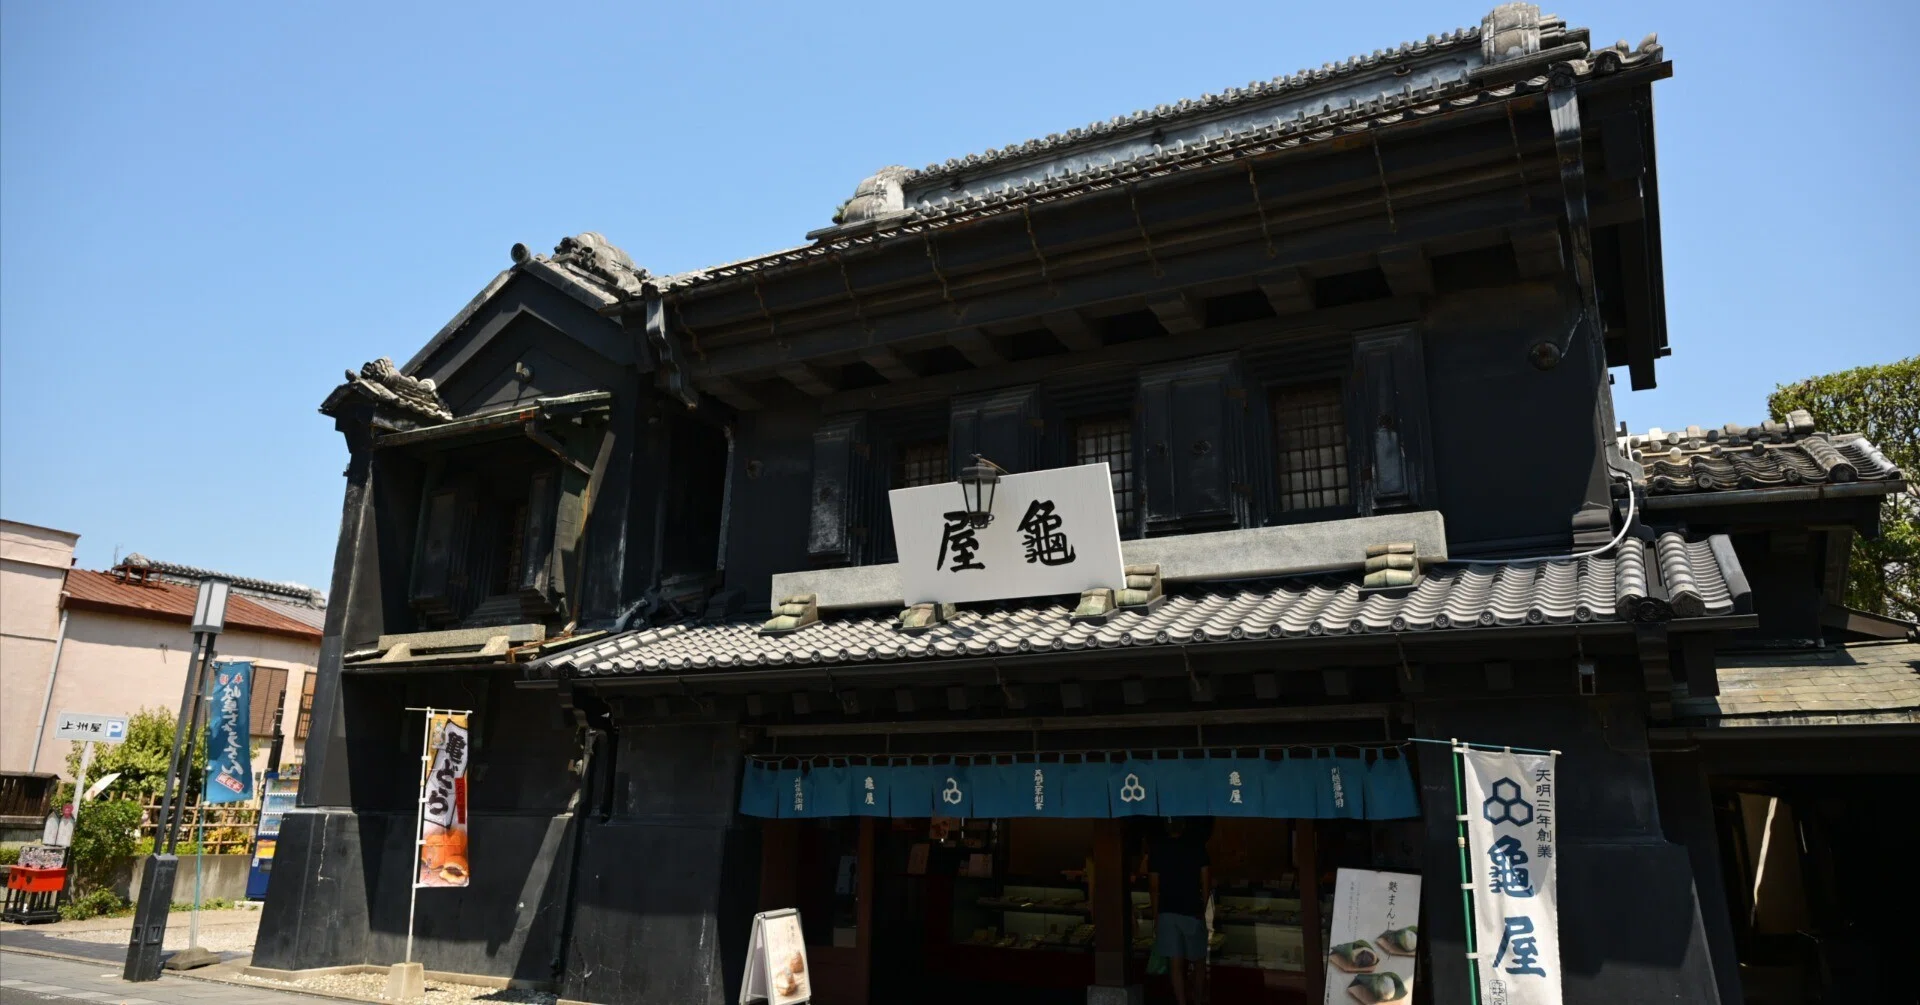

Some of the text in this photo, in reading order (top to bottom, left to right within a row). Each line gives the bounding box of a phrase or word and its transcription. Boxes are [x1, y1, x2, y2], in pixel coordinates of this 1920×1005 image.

[61, 720, 123, 737] 上州屋 P
[1535, 769, 1552, 858] 天明三年創業
